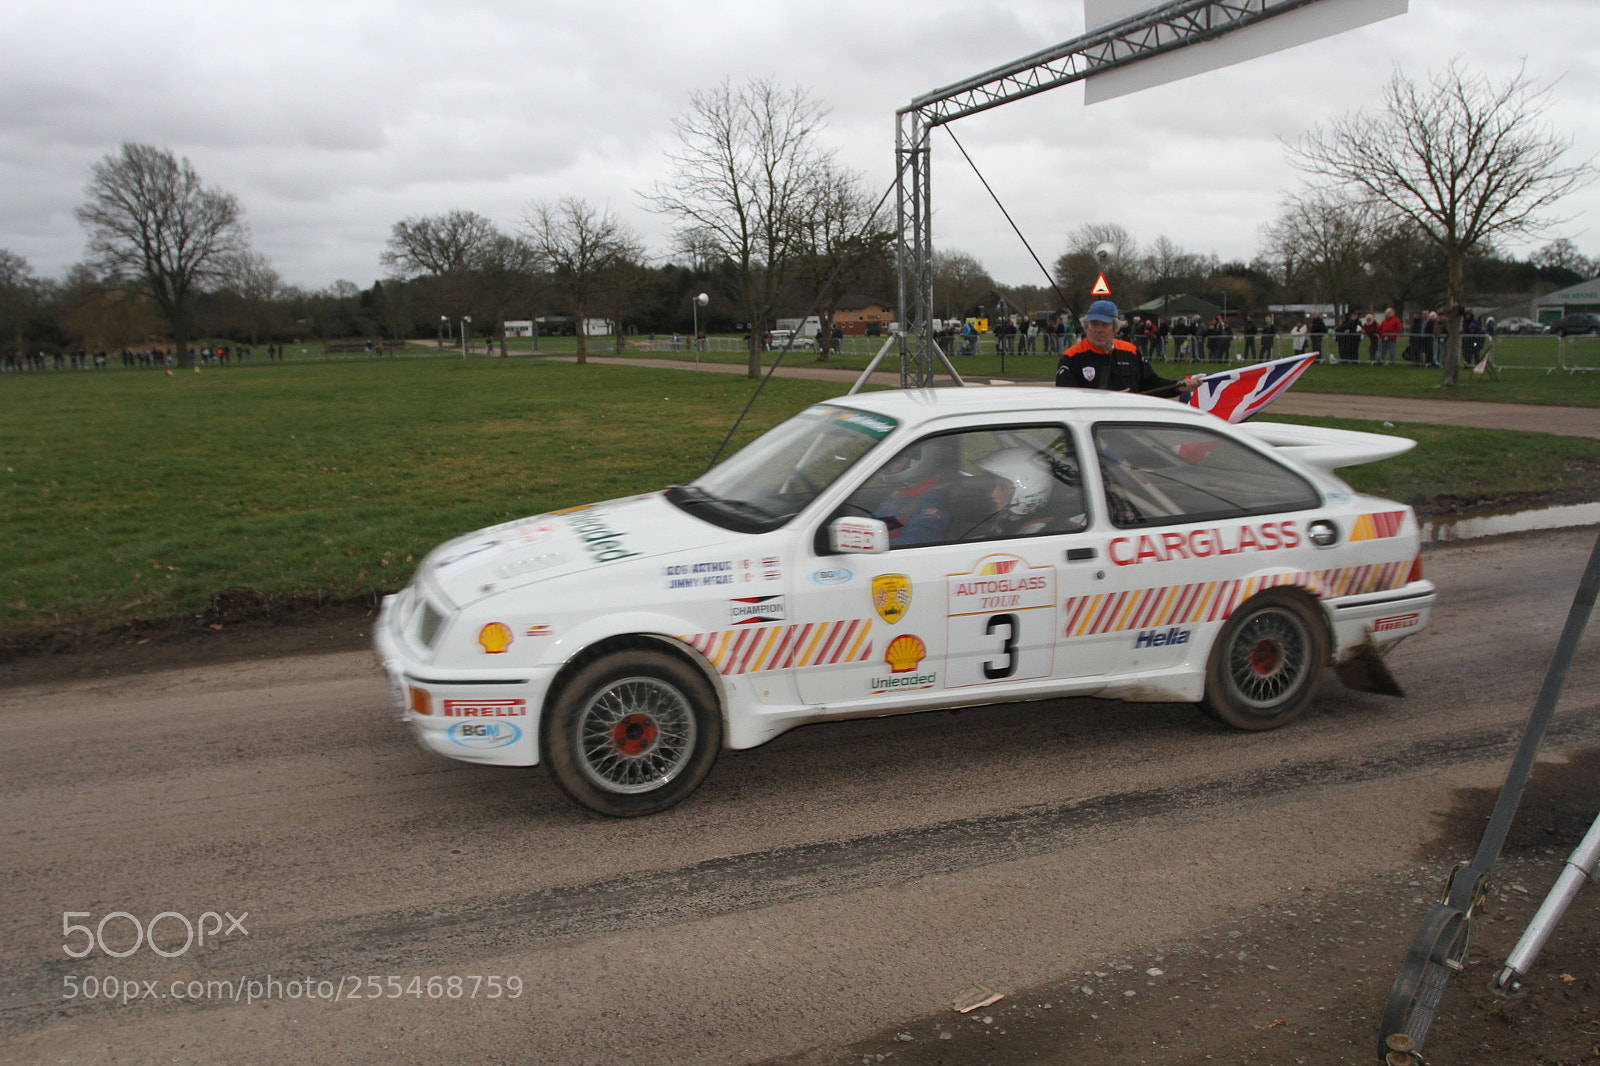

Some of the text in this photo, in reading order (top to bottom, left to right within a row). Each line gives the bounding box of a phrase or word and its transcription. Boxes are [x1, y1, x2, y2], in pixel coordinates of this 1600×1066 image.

[1107, 521, 1301, 566] CARGLASS
[692, 561, 733, 573] ARTHUR
[669, 578, 699, 589] JIMMY
[956, 576, 1048, 597] AUTOGLASS
[732, 603, 784, 617] CHAMPION
[981, 594, 1021, 609] TOUR
[1370, 612, 1422, 633] PIRELLI
[982, 613, 1021, 680] 3
[1133, 627, 1192, 649] Hella
[870, 672, 937, 690] Unleaded
[443, 698, 527, 717] PIRELLI
[462, 724, 500, 737] BGM
